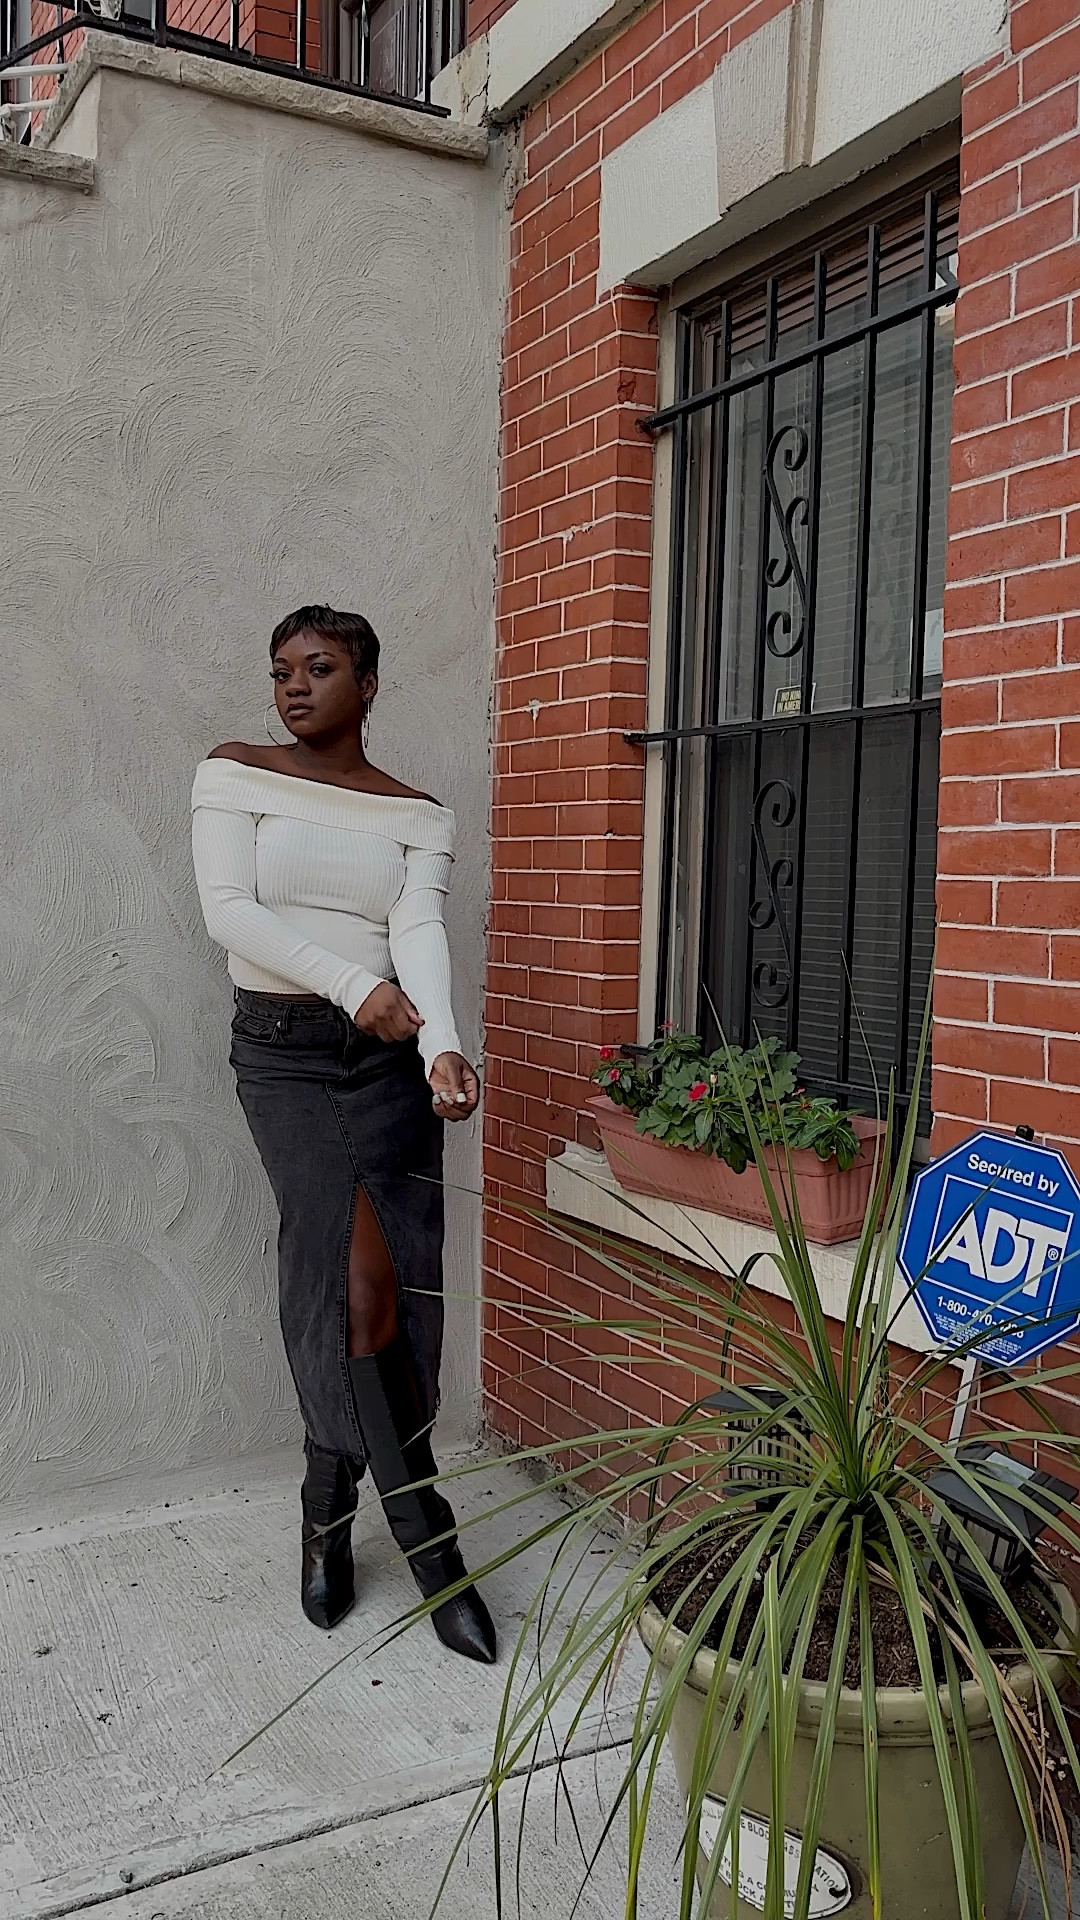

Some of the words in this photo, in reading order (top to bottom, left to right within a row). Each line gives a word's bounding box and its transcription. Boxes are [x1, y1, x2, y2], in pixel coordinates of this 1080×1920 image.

[967, 1153, 1034, 1186] Secured
[1037, 1174, 1060, 1197] by
[931, 1204, 1067, 1298] ADT
